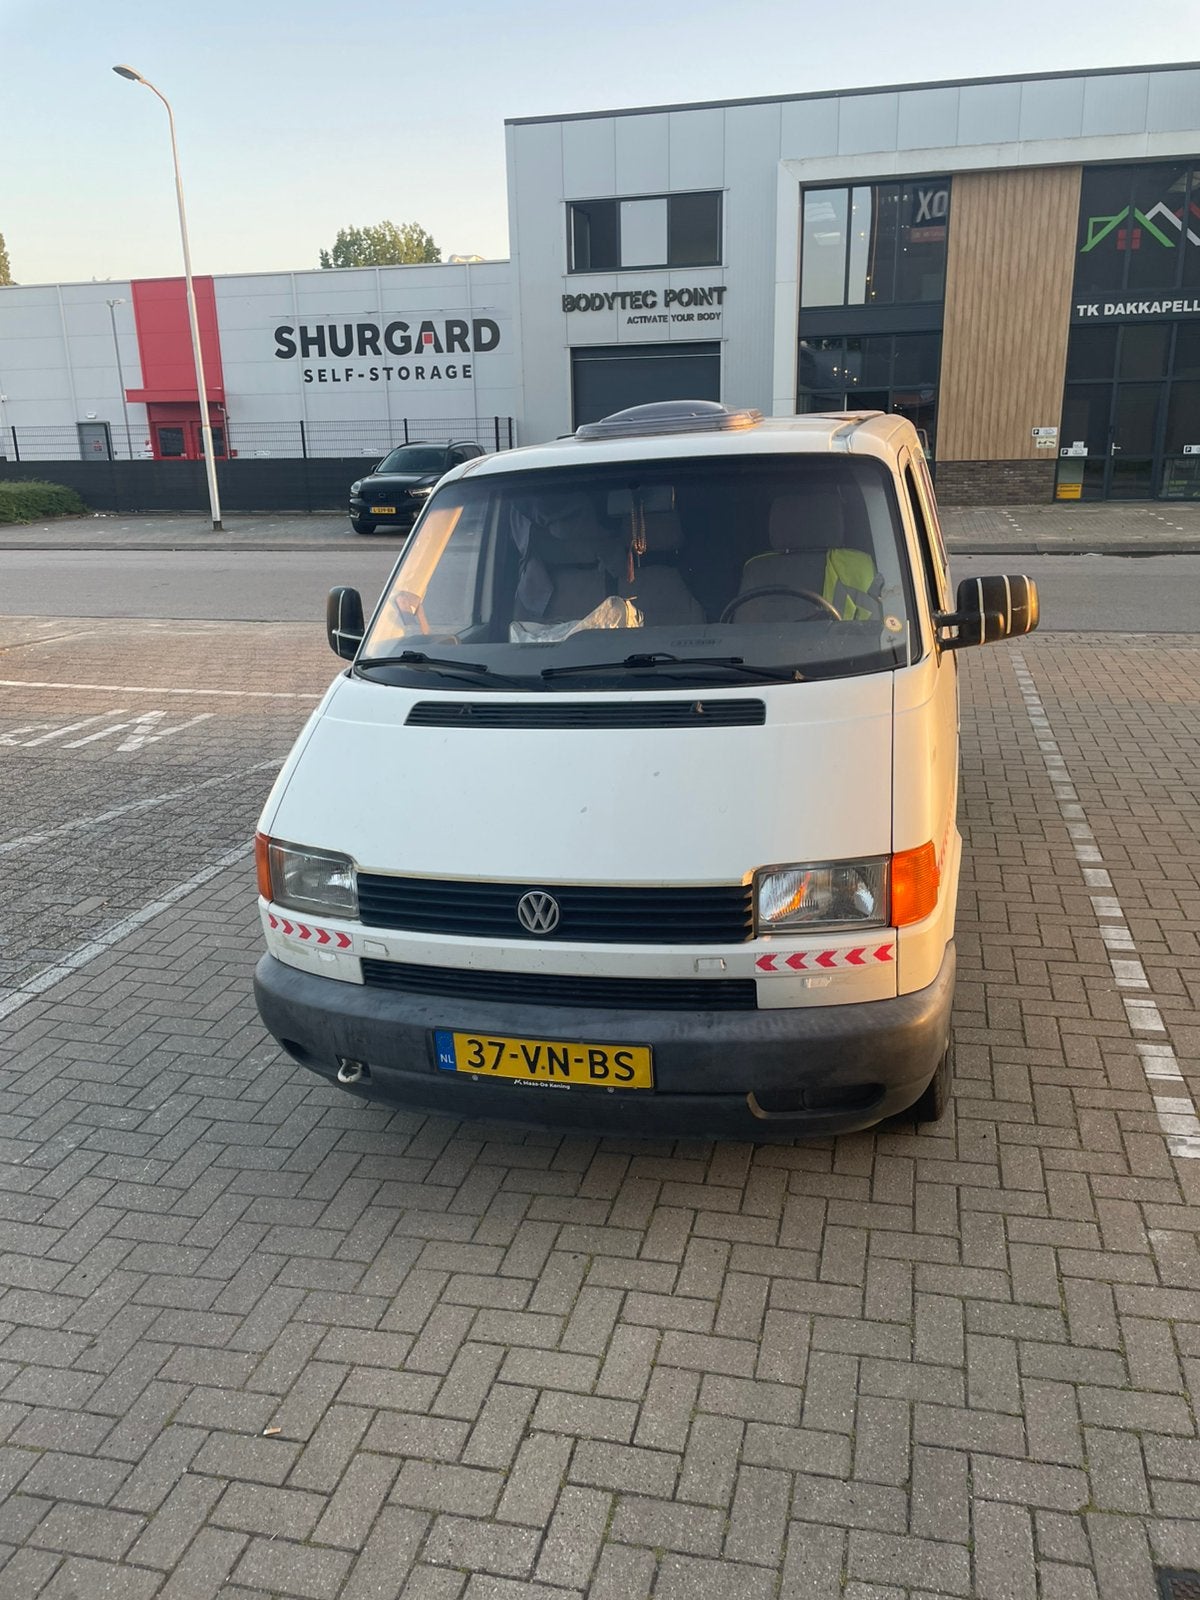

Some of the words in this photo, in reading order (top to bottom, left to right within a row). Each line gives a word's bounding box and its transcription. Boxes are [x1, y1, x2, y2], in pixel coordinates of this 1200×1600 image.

[562, 290, 658, 312] BODYTEC
[664, 286, 727, 308] POINT
[1077, 304, 1099, 317] TK
[1104, 300, 1200, 316] DAKKAPELL
[627, 314, 669, 325] ACTIVATE
[671, 313, 695, 322] YOUR
[697, 312, 721, 321] BODY
[274, 318, 500, 359] SHURGARD
[303, 364, 473, 383] SELF-STORAGE
[440, 1053, 454, 1065] NL
[466, 1038, 636, 1082] 37-VN-BS
